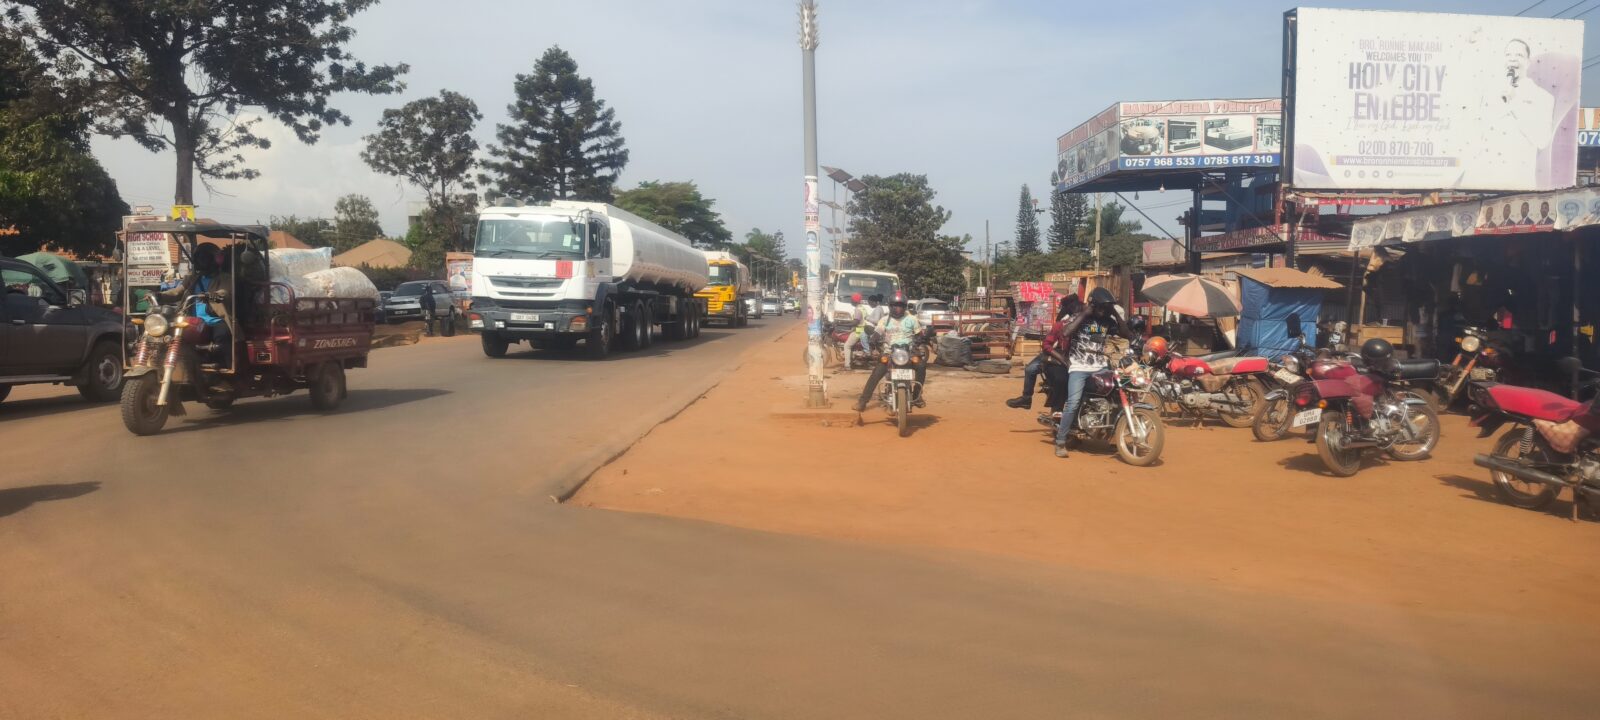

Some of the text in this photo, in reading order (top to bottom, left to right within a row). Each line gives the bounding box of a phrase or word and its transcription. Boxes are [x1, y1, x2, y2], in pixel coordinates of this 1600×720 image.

[1379, 39, 1407, 51] RONNIE
[1365, 51, 1407, 62] WELCOMES
[1408, 52, 1422, 62] YOU
[1402, 63, 1447, 92] CITY
[1578, 131, 1600, 145] 07
[1389, 140, 1434, 156] 870-700
[1125, 158, 1150, 167] 0757
[1153, 157, 1173, 166] 968
[1176, 157, 1195, 166] 533
[1204, 156, 1229, 165] 0785
[1232, 156, 1250, 164] 617
[1254, 155, 1273, 164] 310
[142, 232, 166, 242] SCHOOL
[142, 269, 162, 277] CHURC
[313, 337, 358, 349] ZONGSHEN
